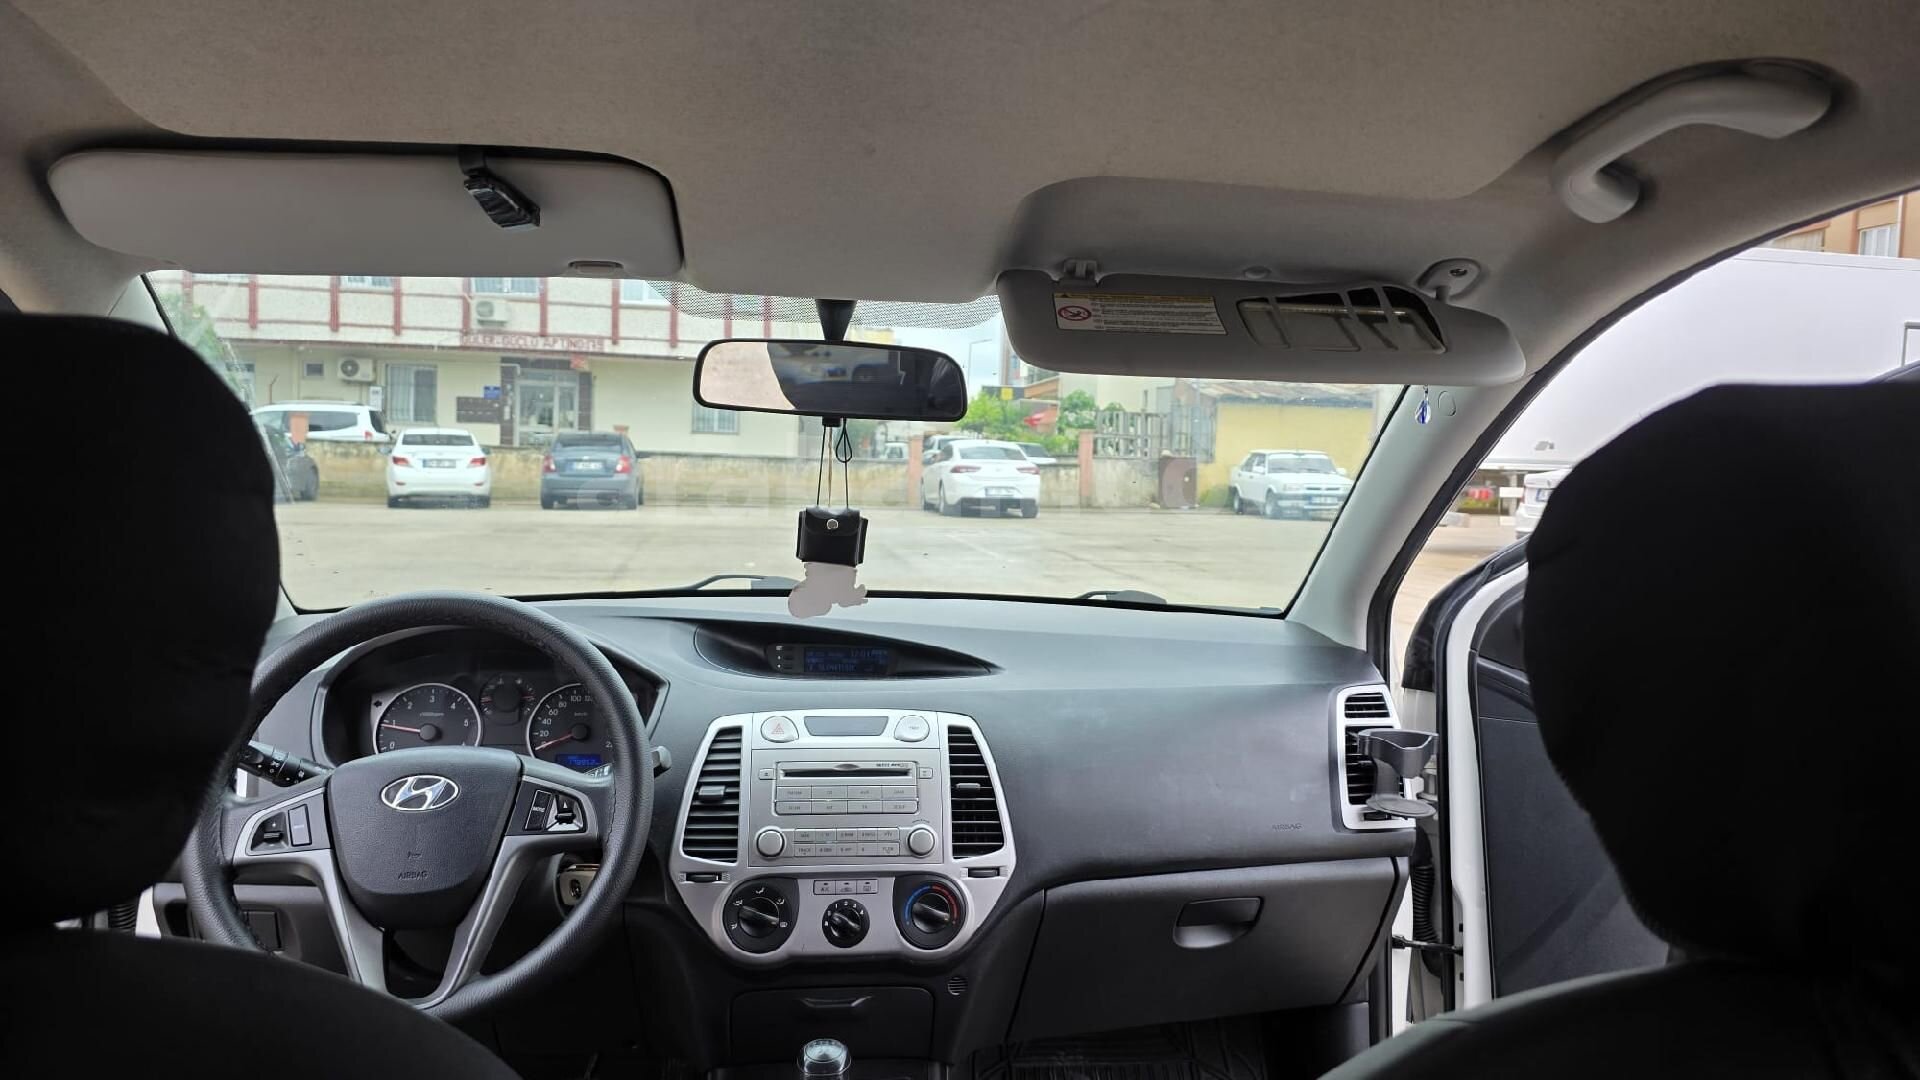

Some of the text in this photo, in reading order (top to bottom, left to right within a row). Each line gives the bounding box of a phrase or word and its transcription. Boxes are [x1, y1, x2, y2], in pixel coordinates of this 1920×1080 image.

[429, 695, 436, 703] 3
[407, 701, 413, 710] 2
[450, 702, 456, 710] 4
[463, 719, 469, 727] 5
[389, 741, 395, 749] 0
[1271, 822, 1303, 830] AIRBAG
[398, 870, 428, 880] AIRBAG
